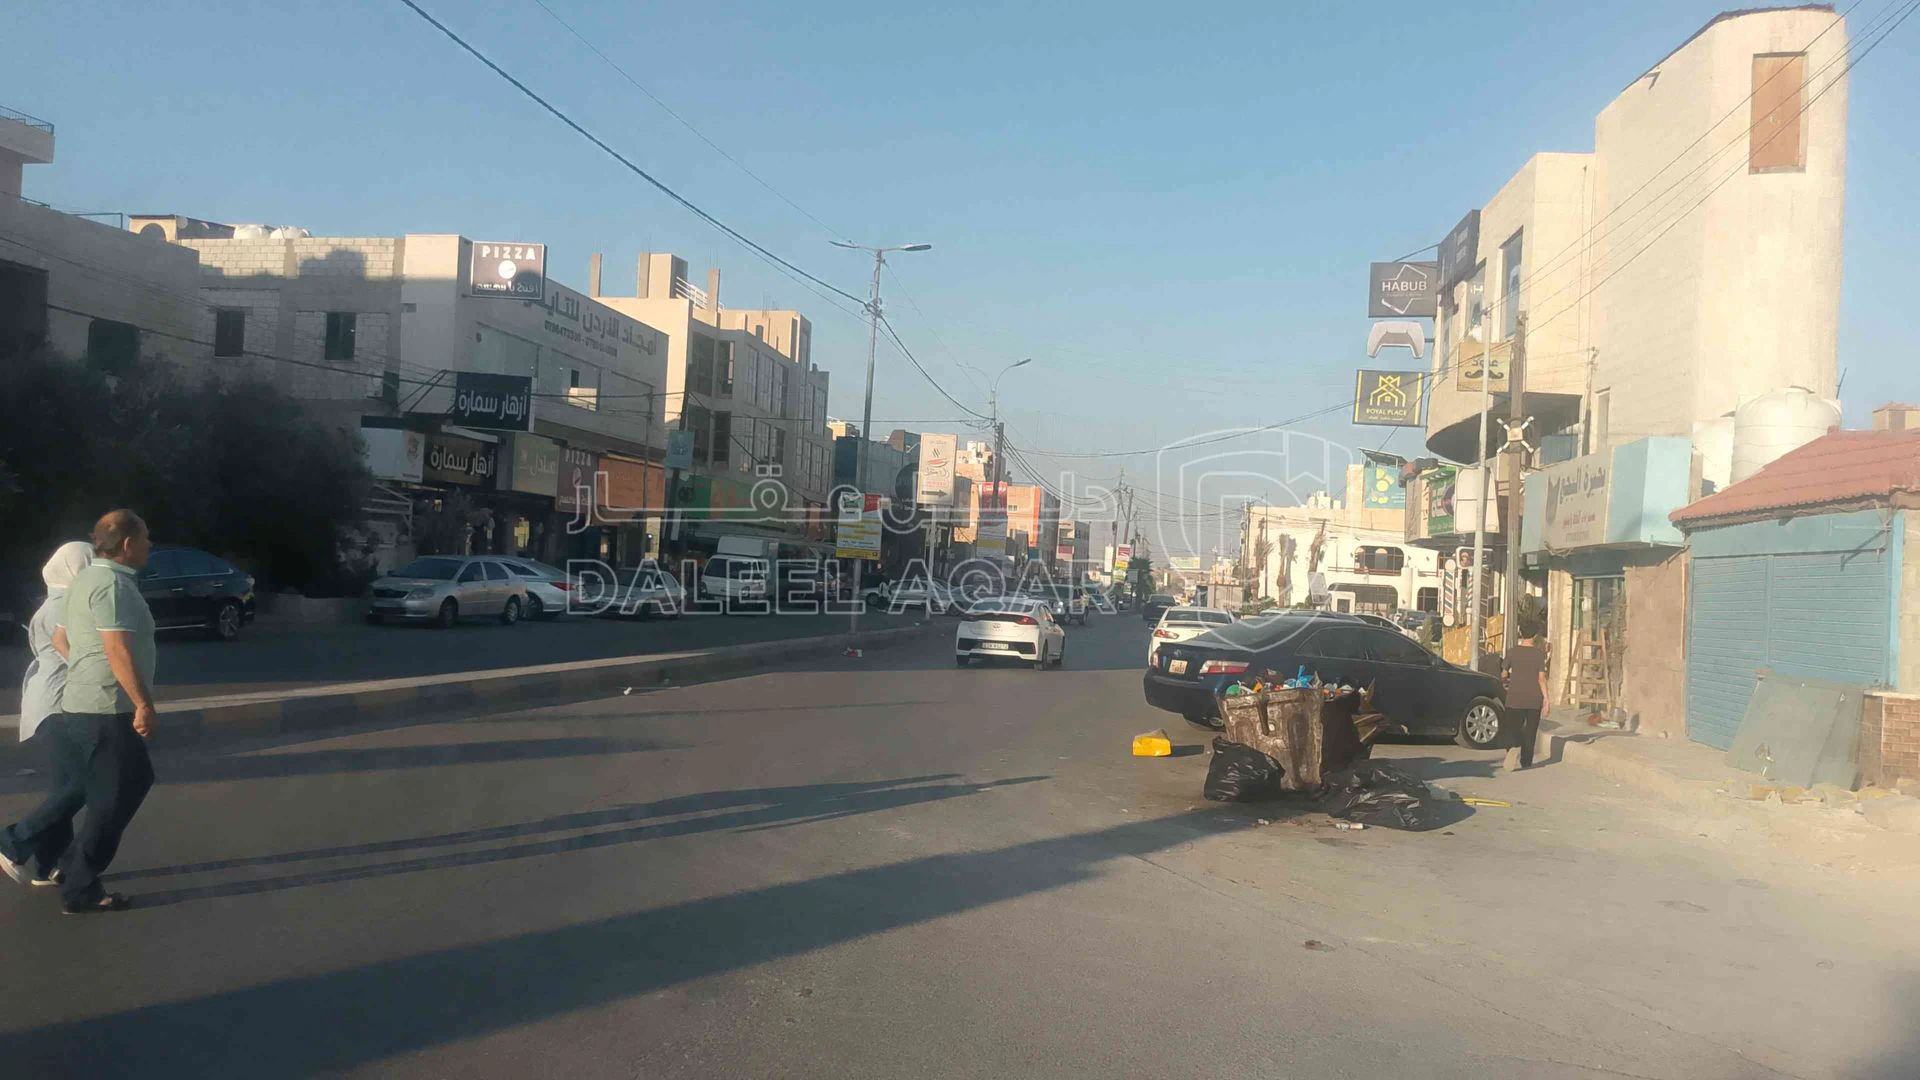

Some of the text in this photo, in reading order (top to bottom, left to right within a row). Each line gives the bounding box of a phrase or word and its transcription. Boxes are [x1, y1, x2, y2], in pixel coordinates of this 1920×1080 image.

[482, 245, 536, 260] PIZZA
[1382, 280, 1427, 292] HABUB
[458, 388, 498, 417] سمارة
[430, 444, 468, 471] سمارة
[565, 450, 591, 466] PIZZA
